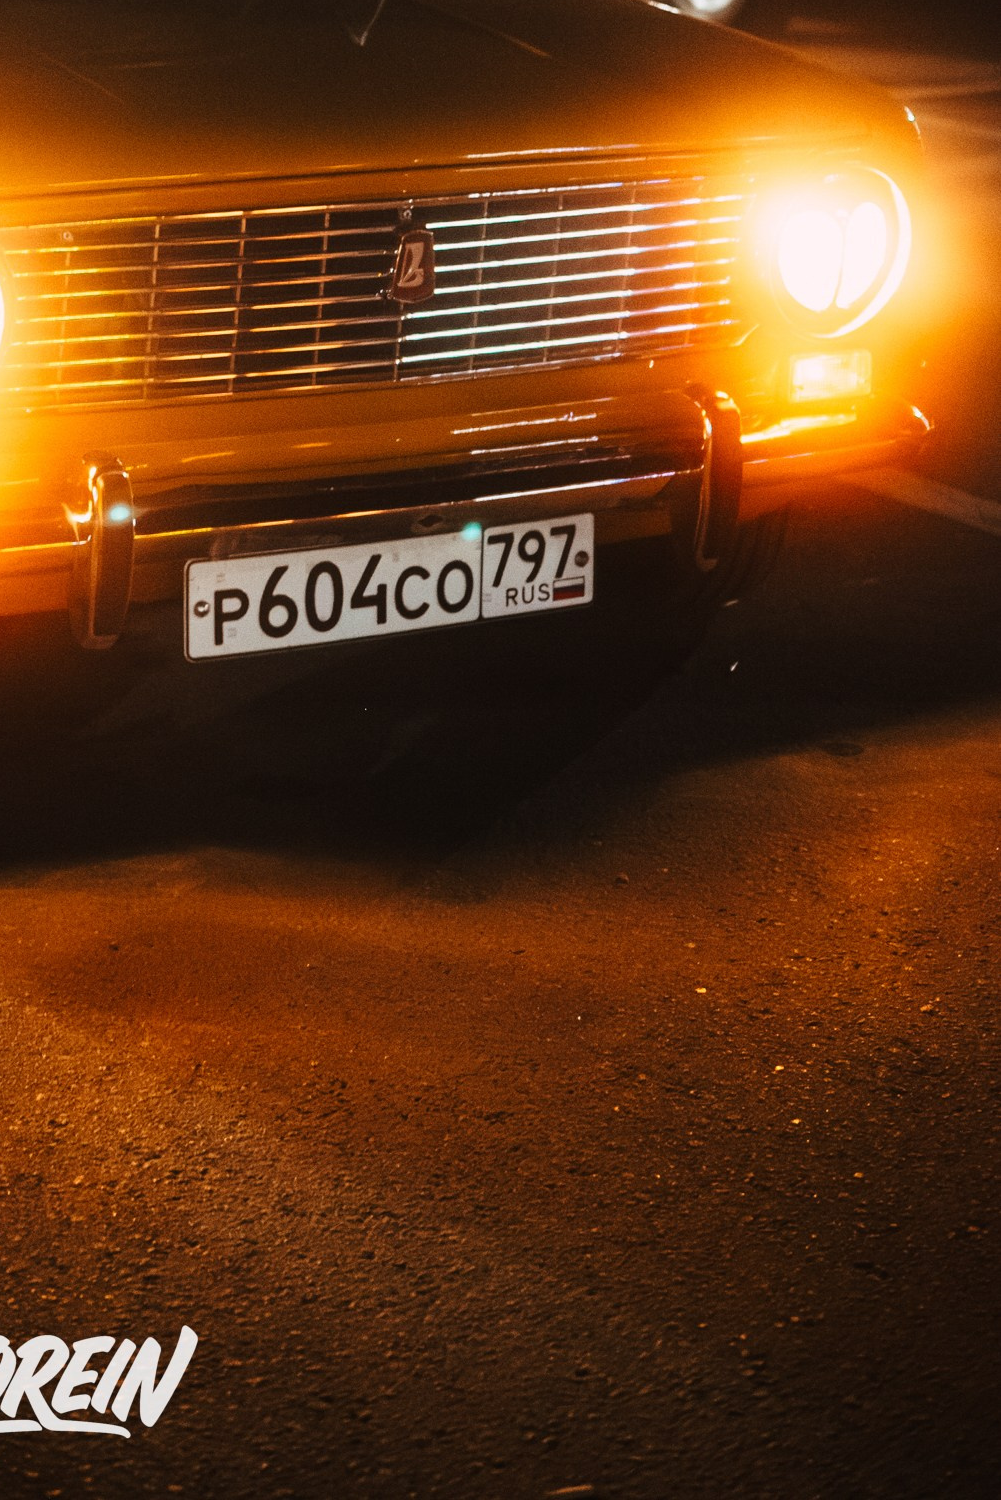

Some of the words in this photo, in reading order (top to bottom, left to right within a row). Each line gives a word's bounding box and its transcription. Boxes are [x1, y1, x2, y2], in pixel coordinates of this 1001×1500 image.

[212, 553, 474, 646] P604CO
[487, 523, 577, 588] 797
[505, 582, 551, 608] RUS
